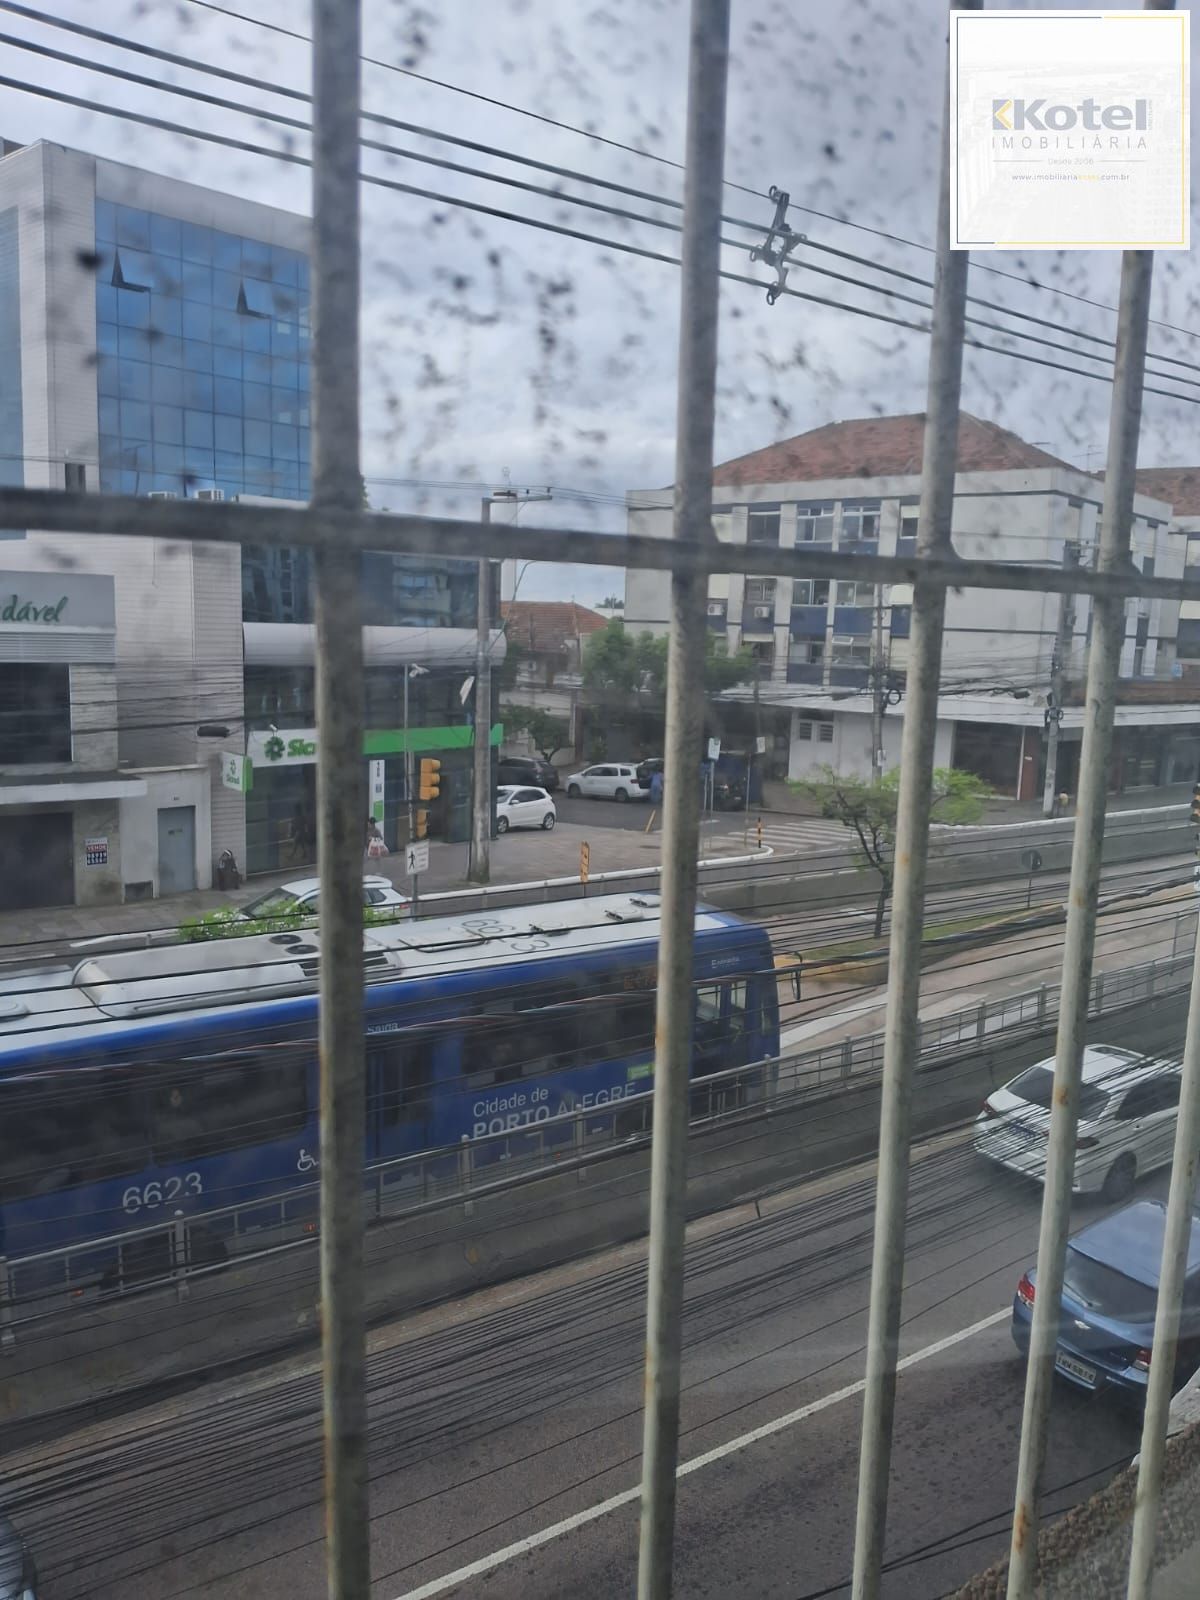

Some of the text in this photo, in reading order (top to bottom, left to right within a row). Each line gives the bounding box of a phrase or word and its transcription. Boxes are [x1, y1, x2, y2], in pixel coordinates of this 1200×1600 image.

[0, 594, 69, 622] dável
[473, 1088, 549, 1118] Cidade de
[473, 1105, 550, 1139] PORTO
[122, 1172, 203, 1214] 6623
